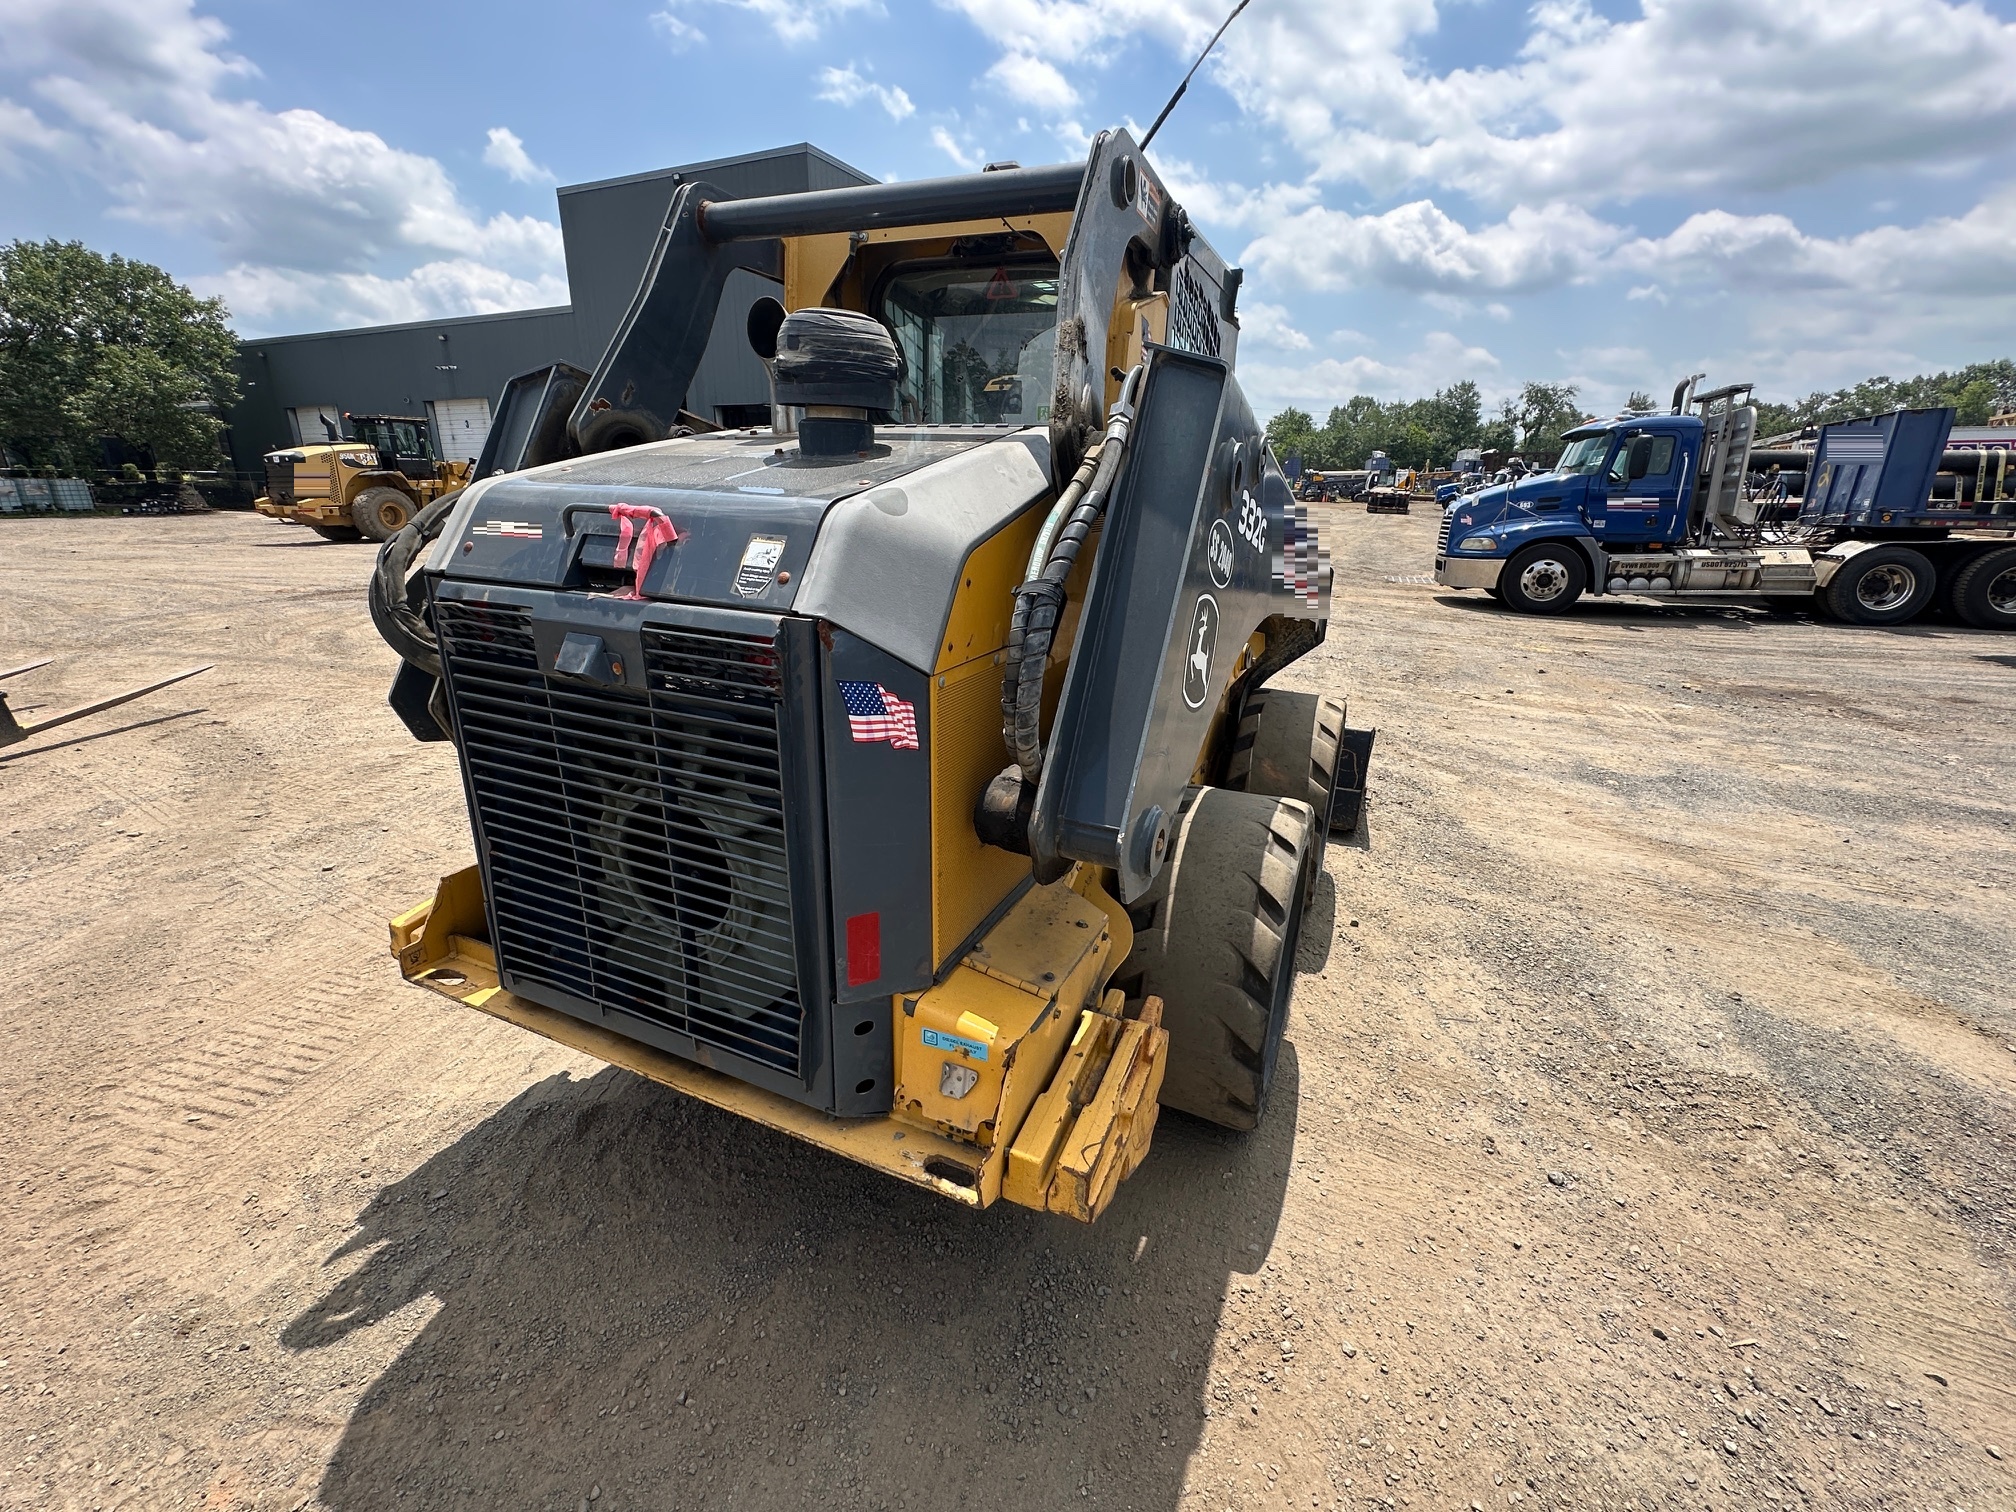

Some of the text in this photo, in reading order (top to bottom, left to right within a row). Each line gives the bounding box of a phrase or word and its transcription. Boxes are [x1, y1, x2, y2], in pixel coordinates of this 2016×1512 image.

[1238, 489, 1267, 553] 332G
[1210, 529, 1220, 562] SS
[942, 1036, 959, 1045] DIESEL
[960, 1041, 982, 1051] EXHAUST
